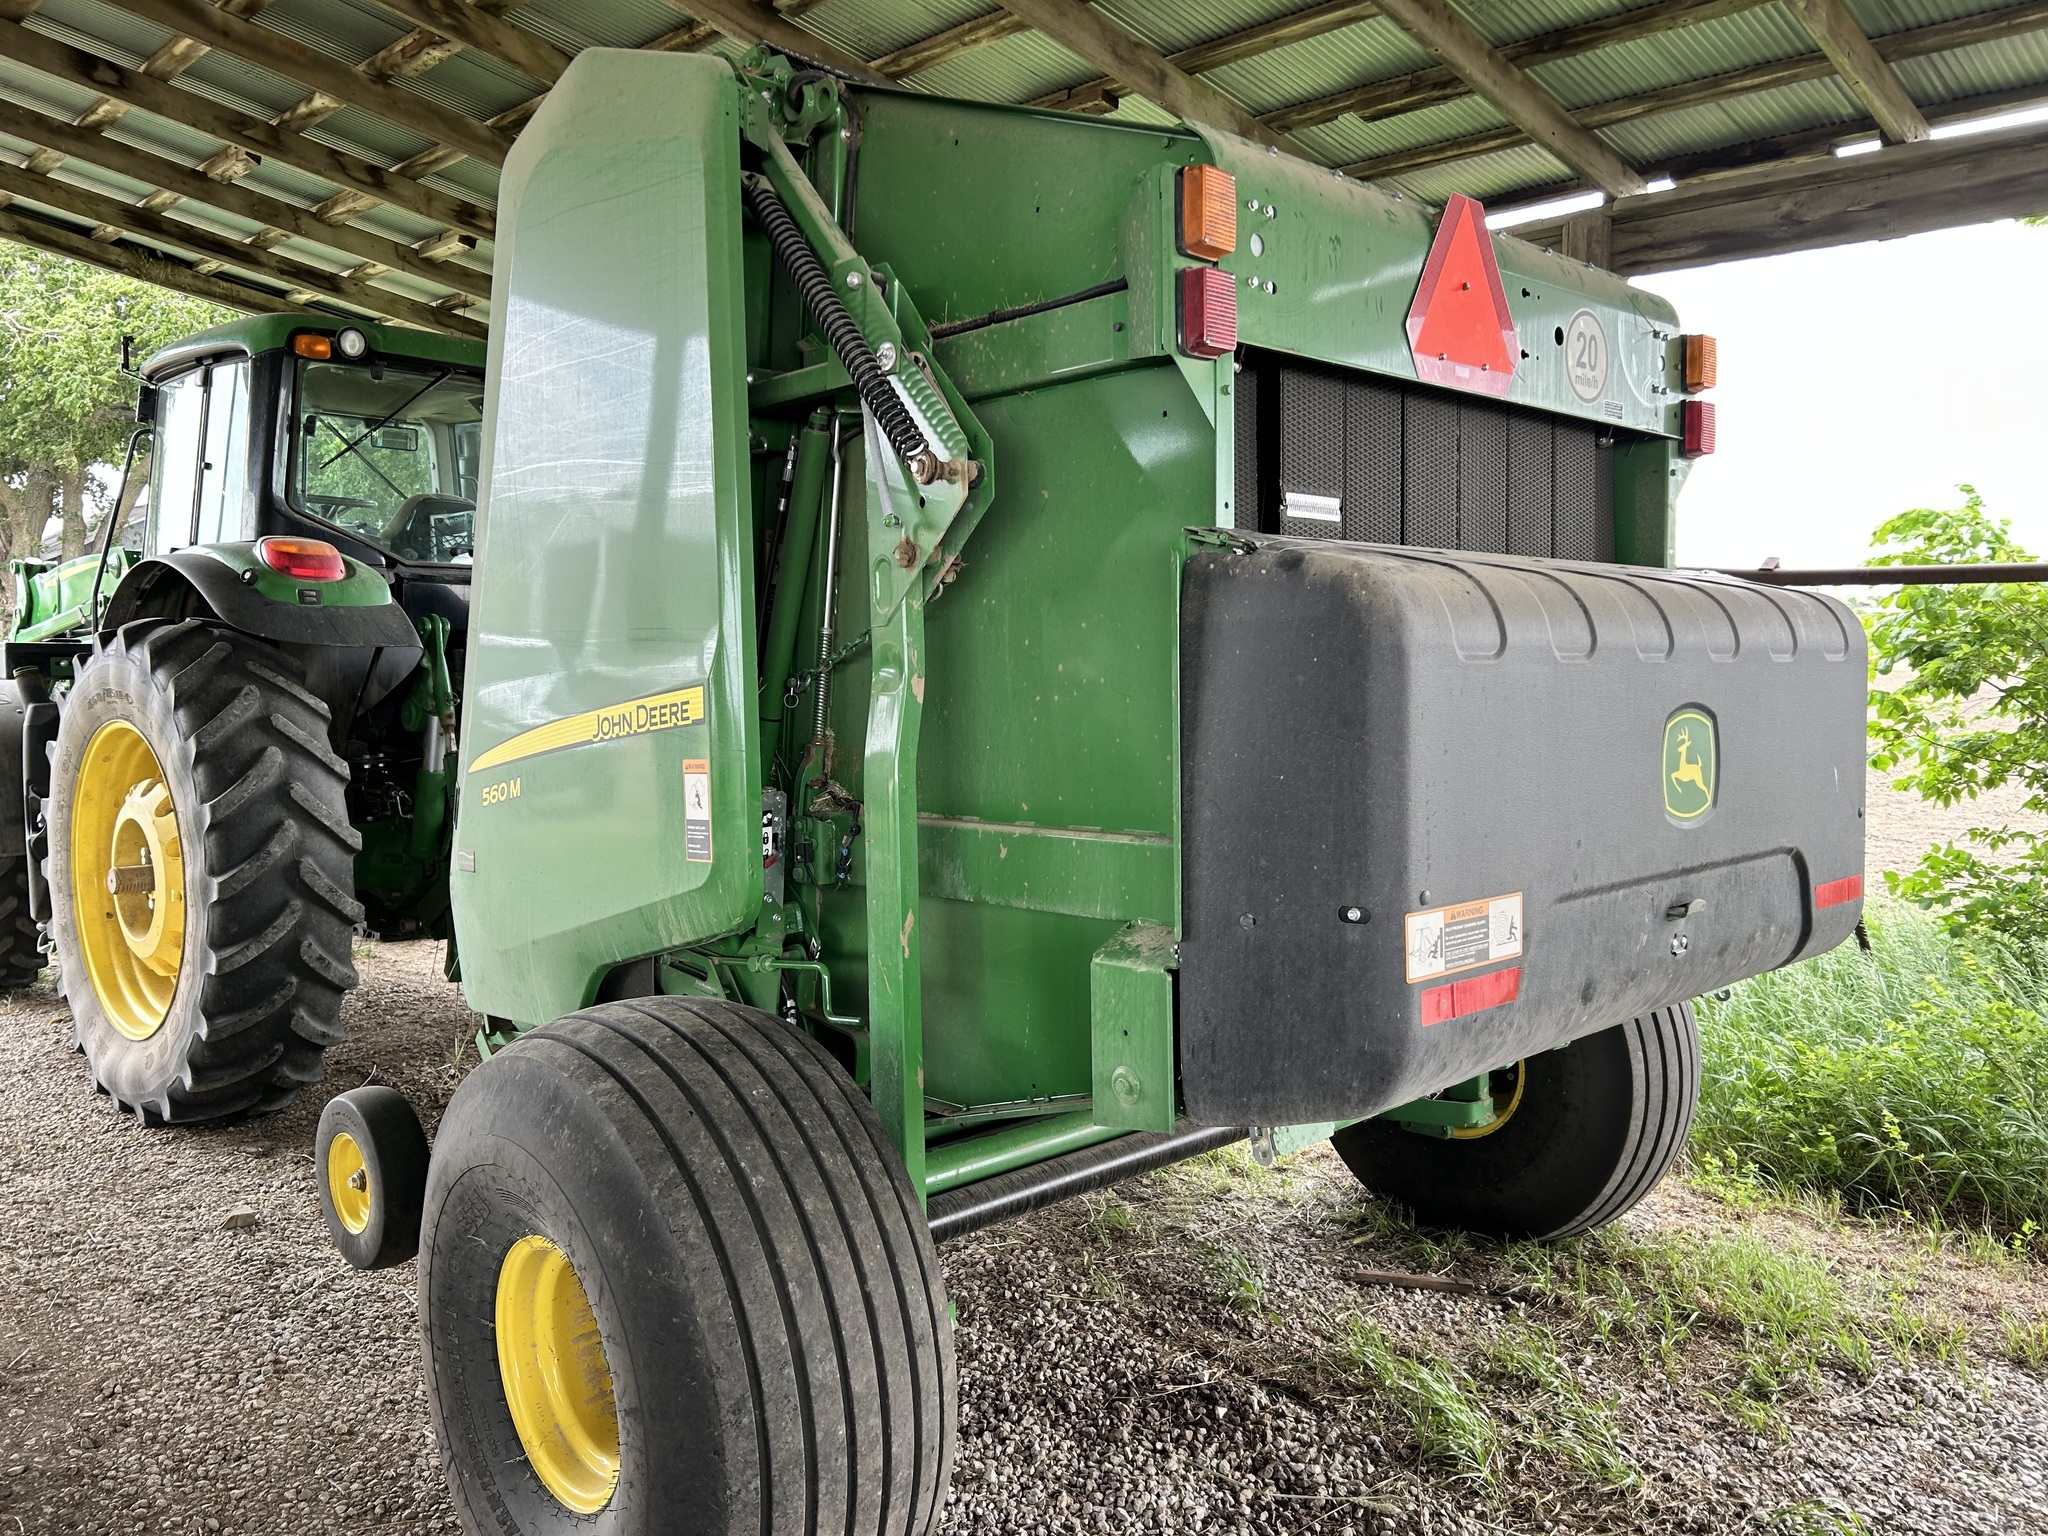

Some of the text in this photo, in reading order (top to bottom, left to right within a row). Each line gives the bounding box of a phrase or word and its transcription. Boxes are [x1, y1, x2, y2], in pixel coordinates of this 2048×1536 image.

[1575, 331, 1598, 372] 20
[1574, 373, 1599, 389] mile/h
[592, 700, 690, 739] JOHN DEERE
[1456, 906, 1484, 918] WARNING
